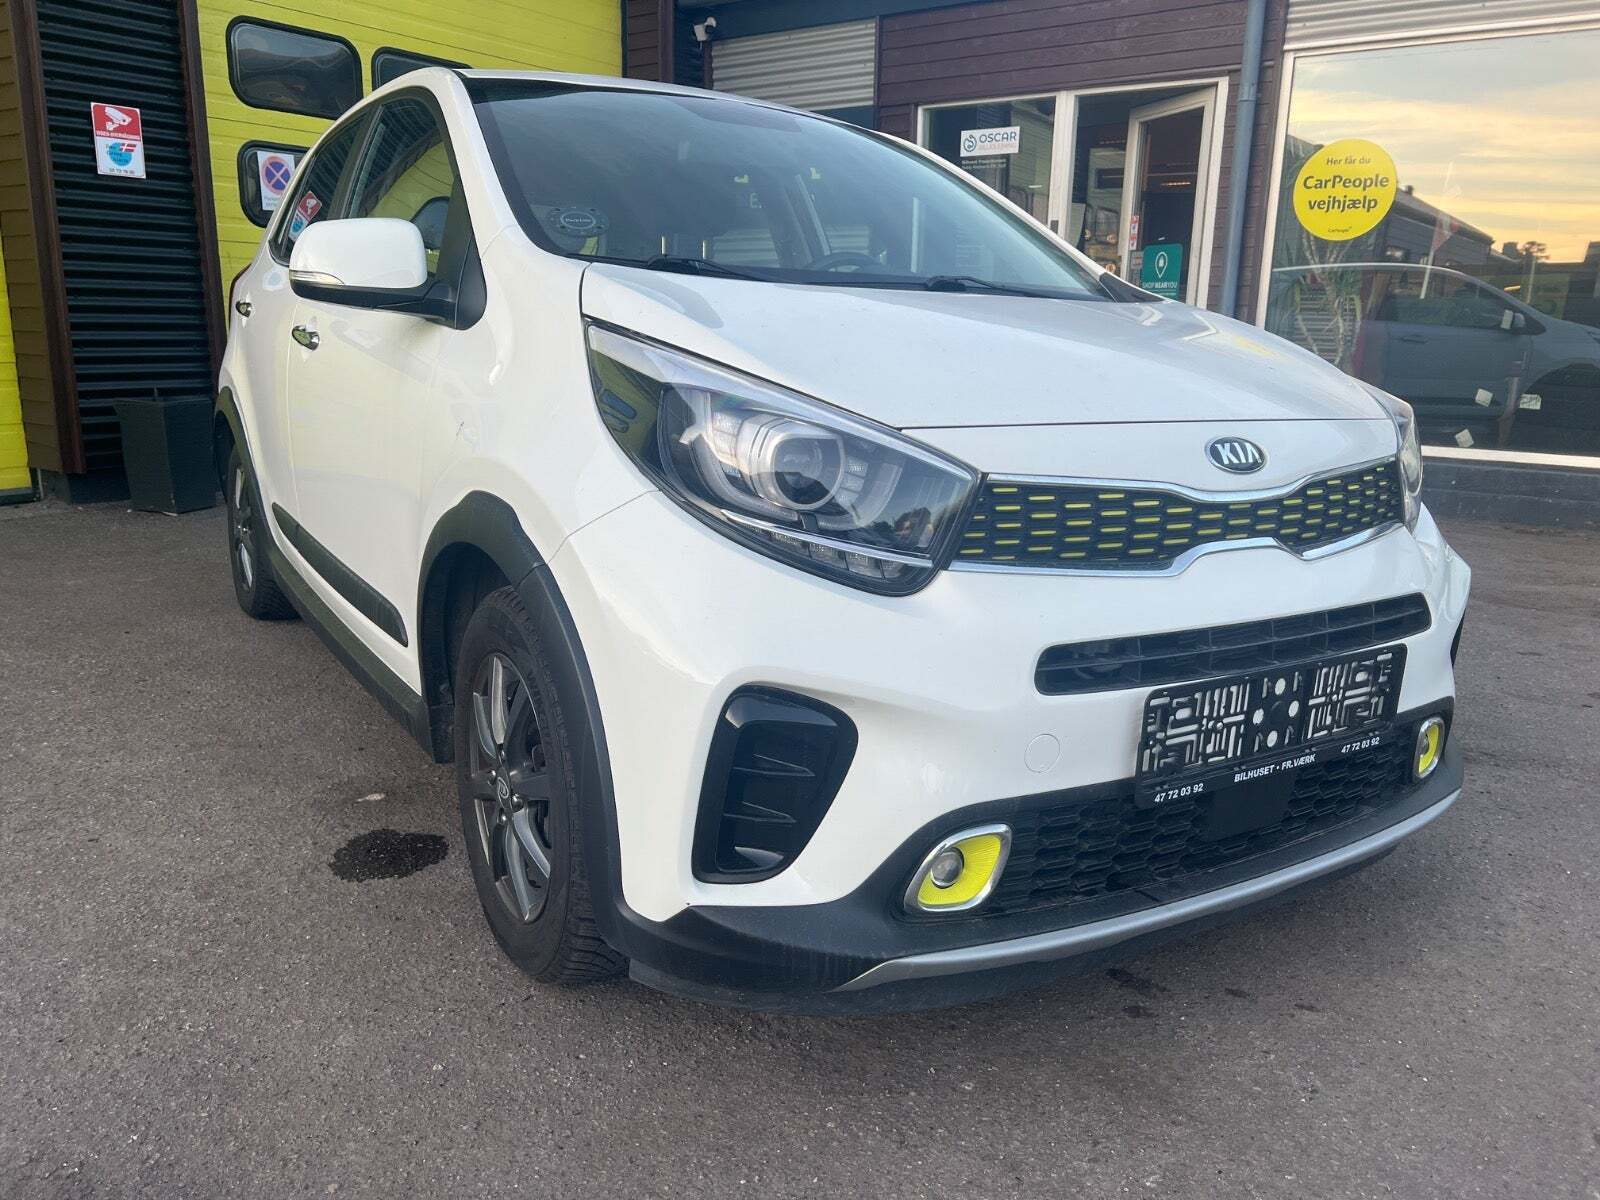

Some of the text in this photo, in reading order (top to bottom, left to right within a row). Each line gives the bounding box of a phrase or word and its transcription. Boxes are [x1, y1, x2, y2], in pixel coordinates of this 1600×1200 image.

[979, 131, 1017, 143] OSCAR
[1326, 155, 1371, 166] Her får du
[1303, 174, 1390, 191] CarPeople
[1308, 195, 1378, 213] vejhjælp
[1215, 442, 1262, 465] KIA
[1341, 737, 1380, 753] 47 72 03 92
[1234, 753, 1316, 783] BILHUSET FR.VÆRK
[1154, 783, 1204, 802] 47 72 03 92
